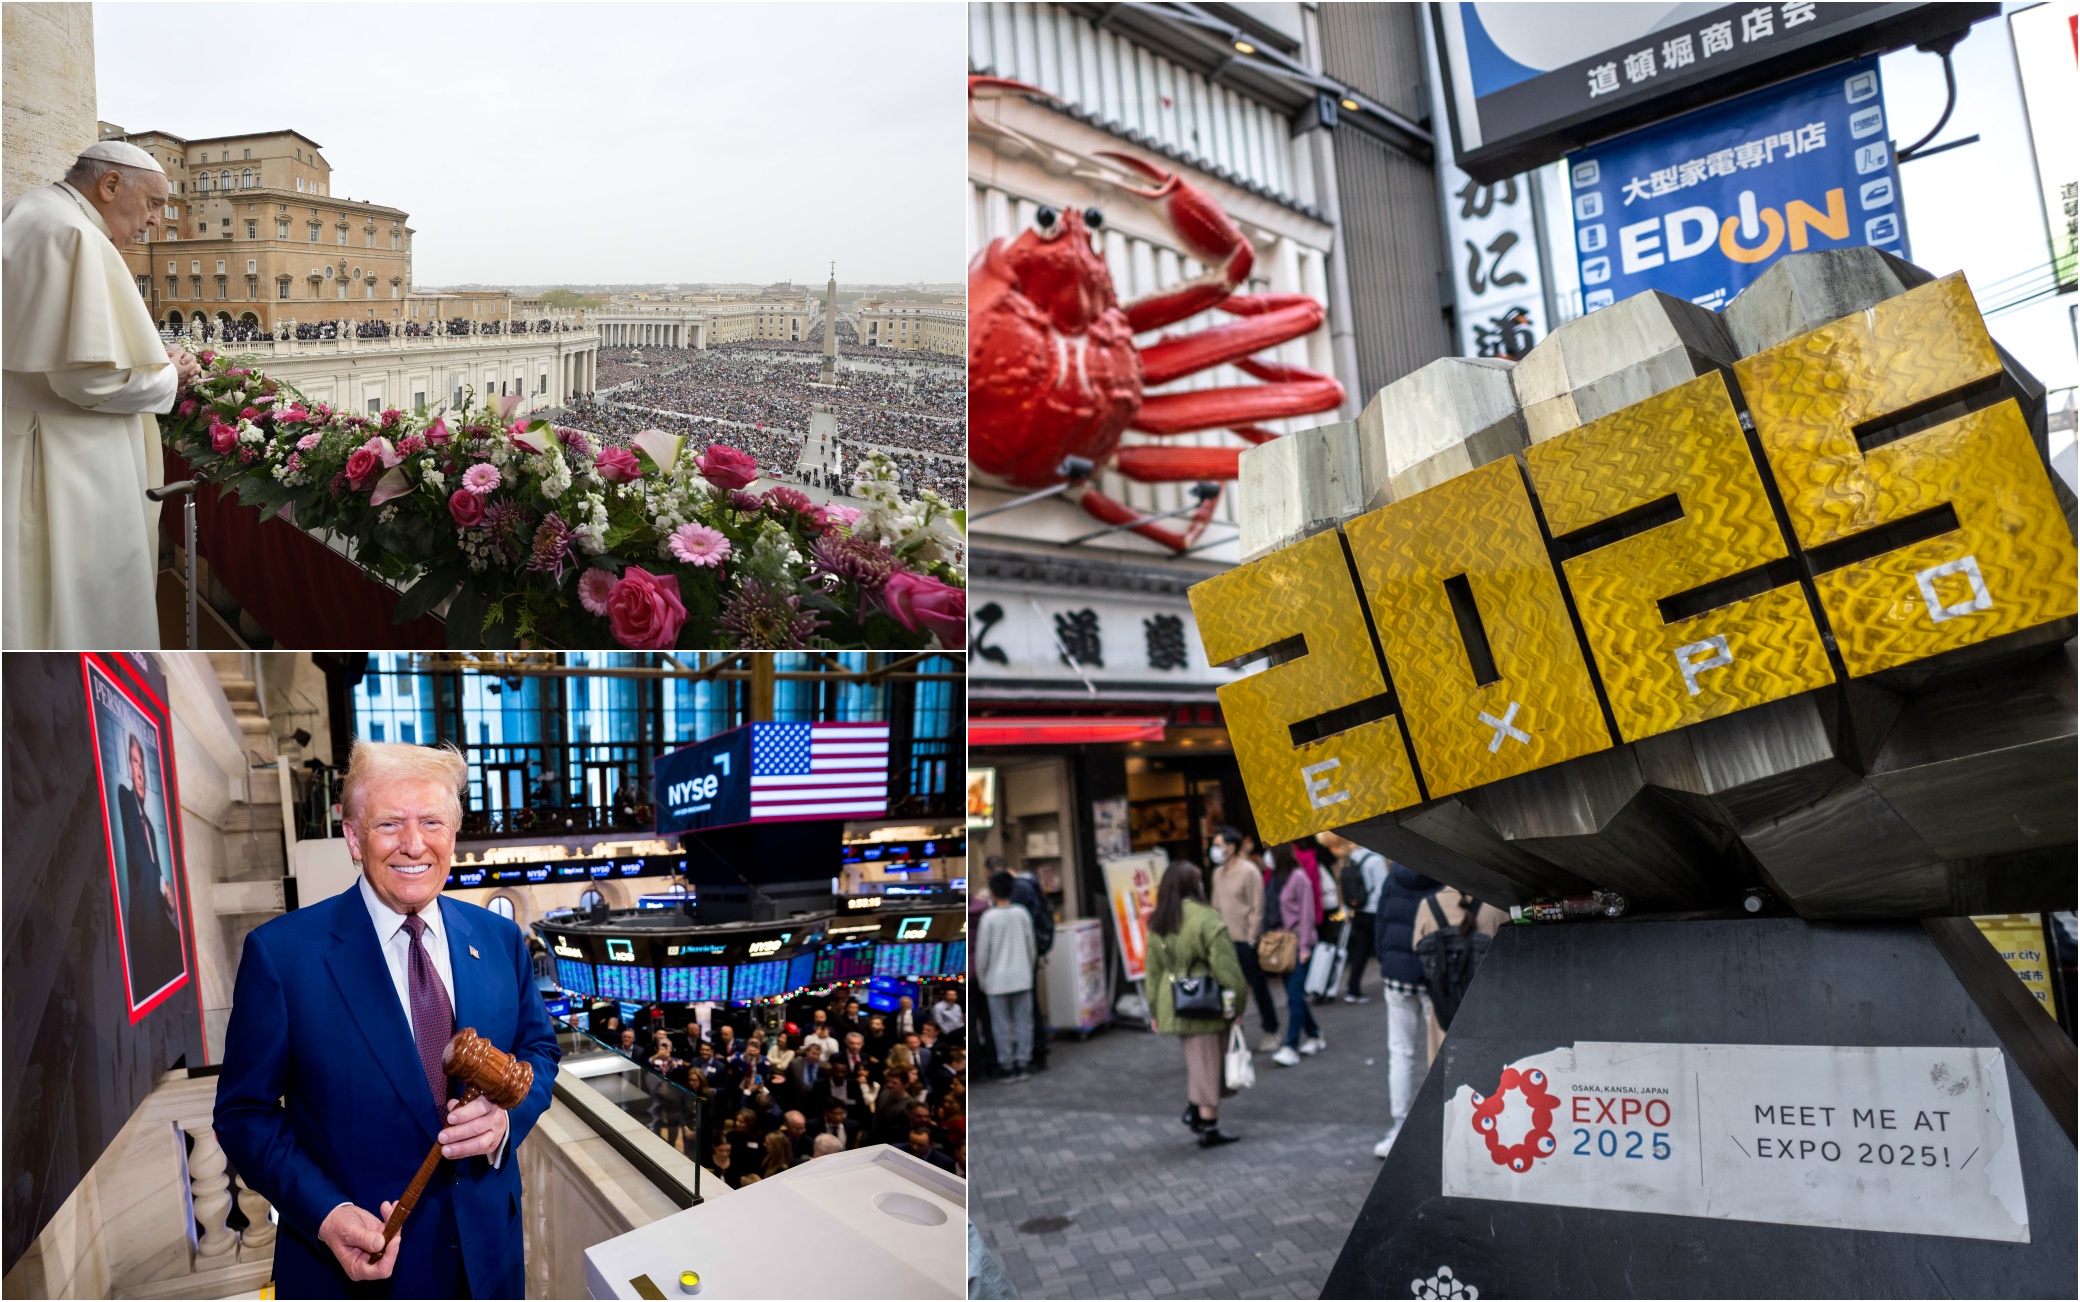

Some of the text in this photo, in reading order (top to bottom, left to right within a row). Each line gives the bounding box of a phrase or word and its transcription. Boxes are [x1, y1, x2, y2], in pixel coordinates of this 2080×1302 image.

[1587, 2, 1817, 98] 道頓堀商店会
[1621, 121, 1827, 206] 大型家電専門店
[1187, 270, 2079, 848] 2025
[2019, 949, 2041, 962] city
[2017, 970, 2044, 982] 城市
[1572, 1085, 1669, 1095] OSAKA, KANSAI, JAPAN
[1572, 1096, 1671, 1127] EXPO
[1755, 1104, 1951, 1132] MEET ME AT
[1573, 1128, 1671, 1160] 2025
[1757, 1138, 1951, 1168] EXPO 2025!
